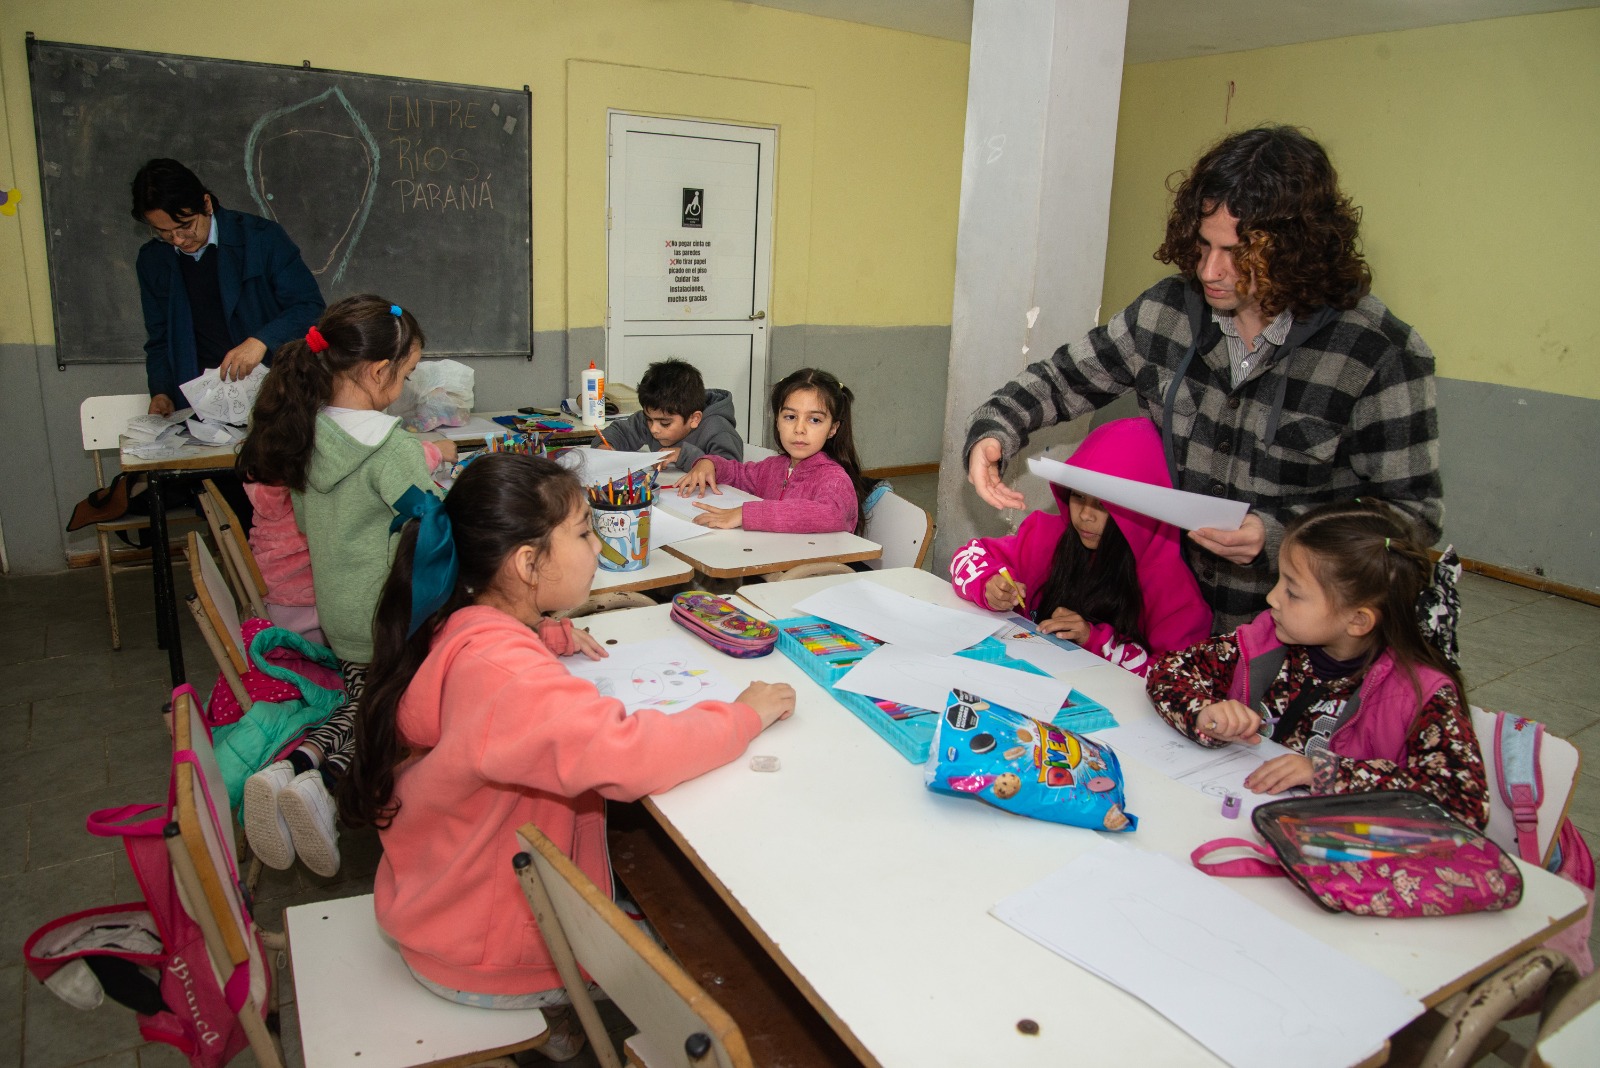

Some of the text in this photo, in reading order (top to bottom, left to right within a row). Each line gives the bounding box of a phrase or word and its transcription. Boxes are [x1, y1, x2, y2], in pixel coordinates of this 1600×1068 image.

[388, 95, 480, 131] ENTRE
[389, 136, 479, 181] RÍOS
[391, 173, 494, 214] PARANÁ
